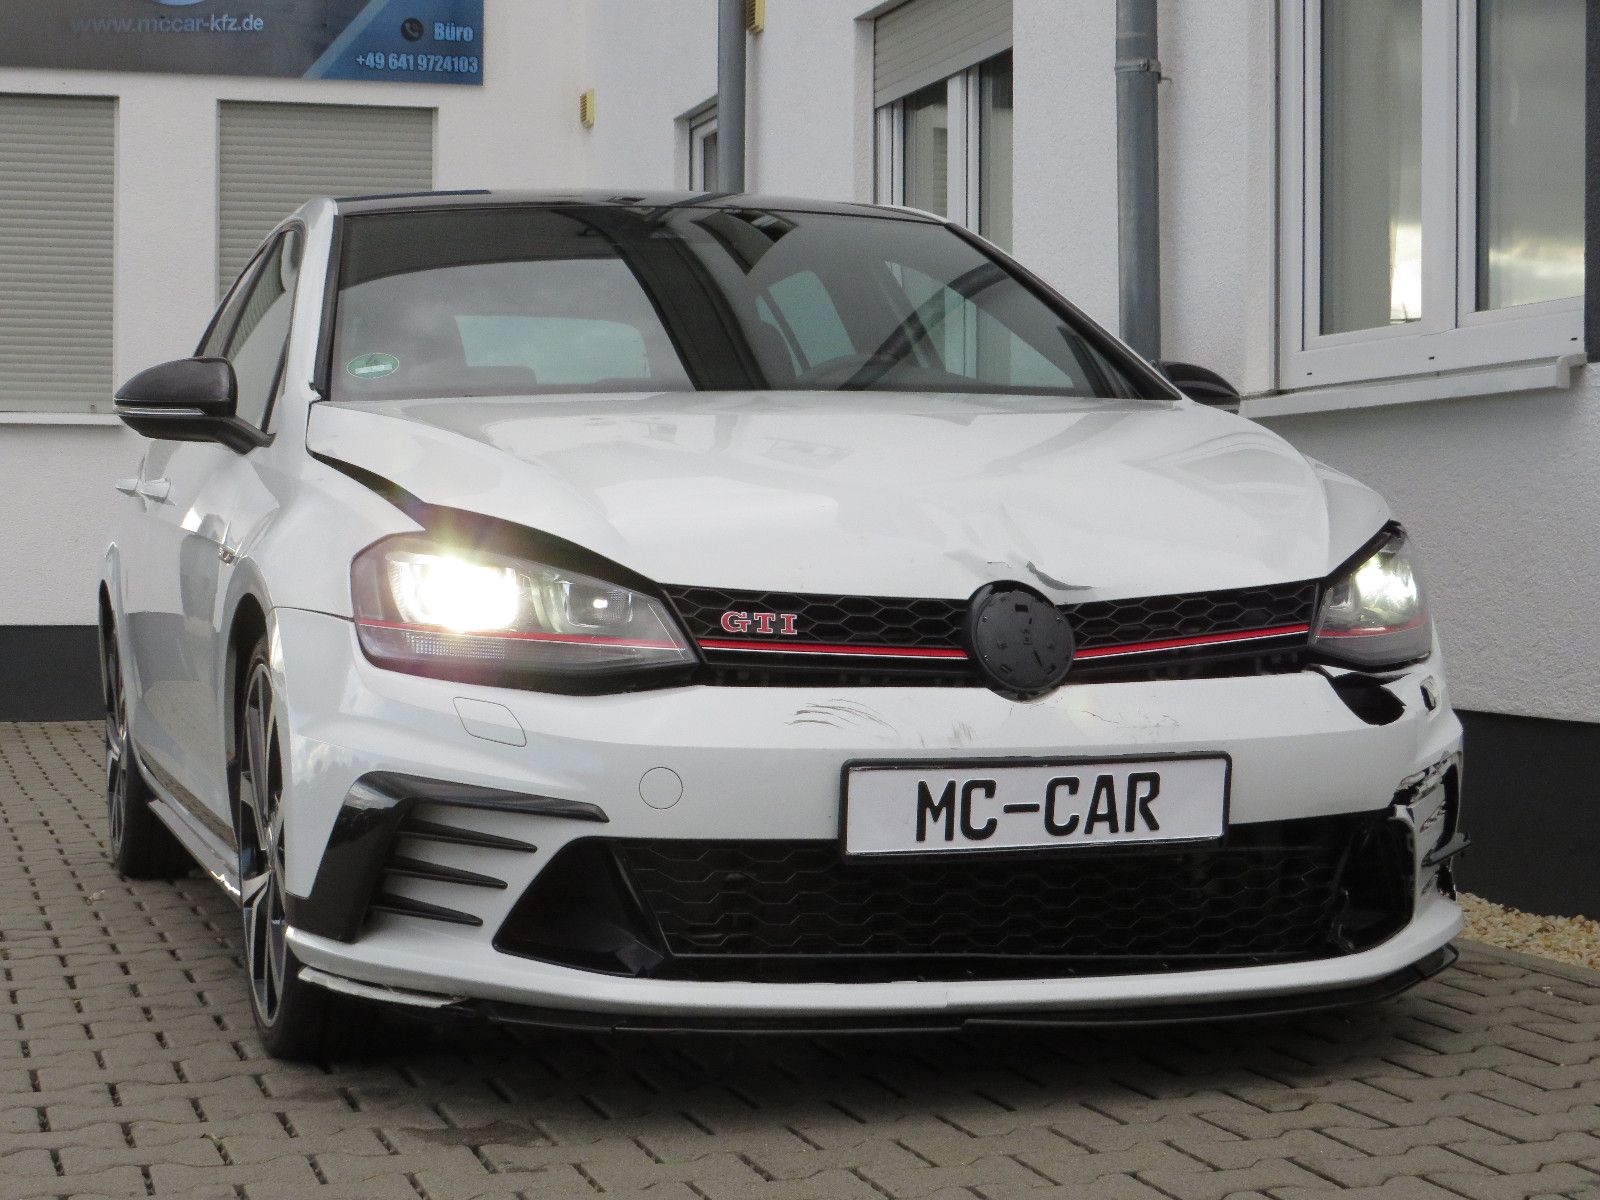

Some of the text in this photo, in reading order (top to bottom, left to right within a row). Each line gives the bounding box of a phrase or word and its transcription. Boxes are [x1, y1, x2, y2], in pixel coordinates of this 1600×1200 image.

[72, 14, 264, 33] www.mccar-kfz.de
[433, 21, 474, 42] Büro
[355, 51, 479, 74] +49 641 9724103
[720, 611, 798, 635] GTI
[915, 771, 1161, 842] MC-CAR
